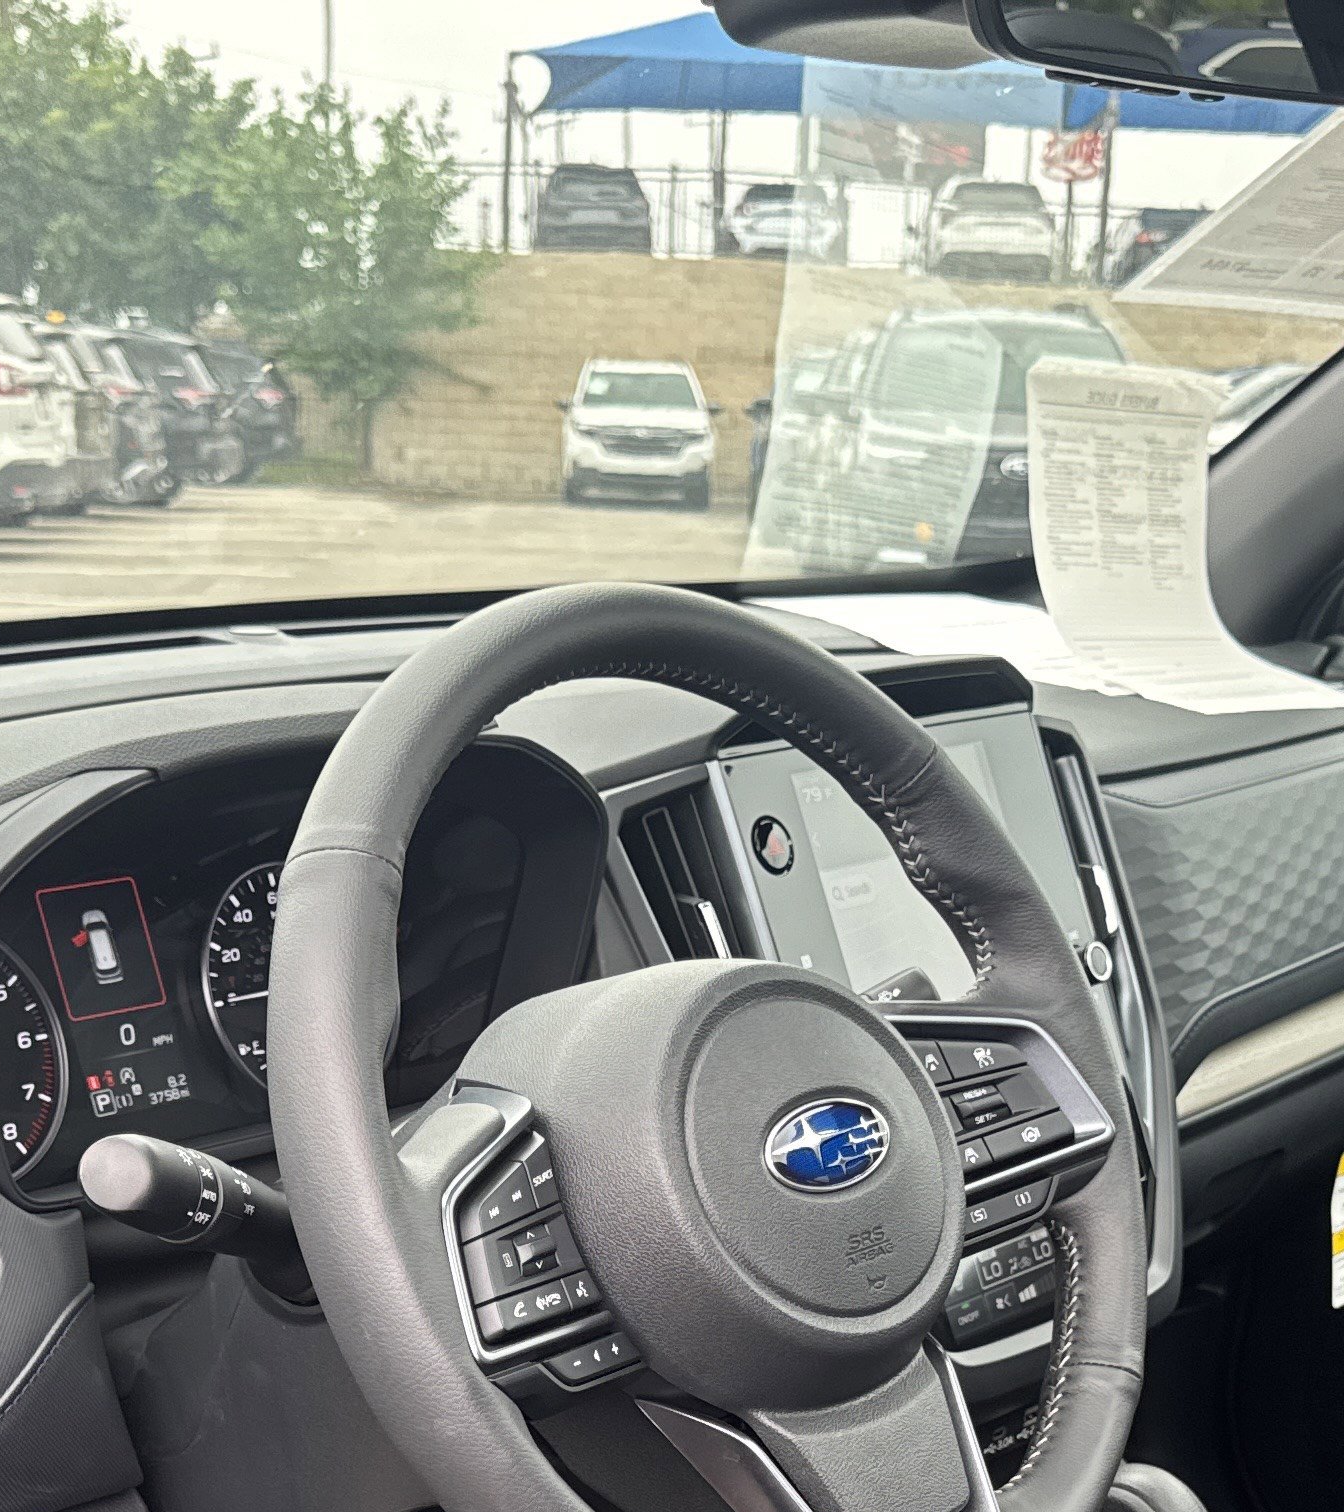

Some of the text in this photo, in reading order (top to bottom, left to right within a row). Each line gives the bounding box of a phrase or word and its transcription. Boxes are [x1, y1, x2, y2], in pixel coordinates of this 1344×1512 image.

[233, 909, 254, 923] 40
[221, 947, 241, 963] 20
[16, 1031, 32, 1050] 6
[119, 1023, 174, 1047] 0 MPH
[21, 1082, 36, 1101] 7
[95, 1094, 111, 1112] P
[2, 1123, 19, 1141] 8
[194, 1211, 212, 1225] OFF
[847, 1225, 886, 1251] SRS
[844, 1242, 895, 1268] AIRBAG
[981, 1240, 1053, 1282] LO LO
